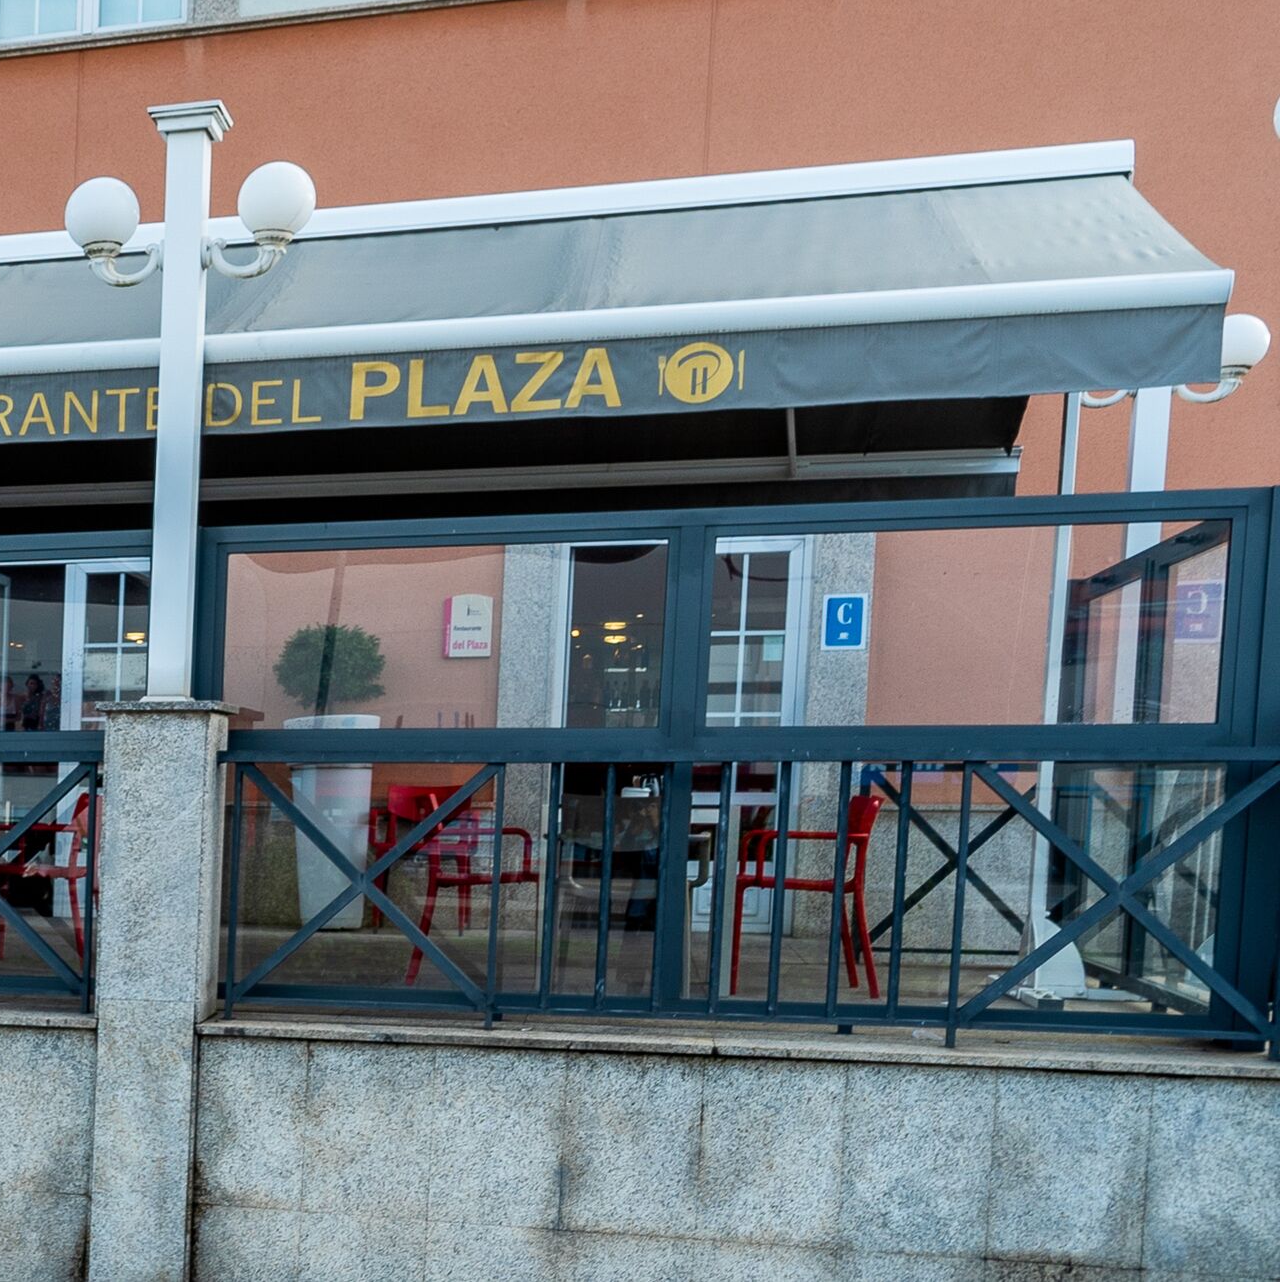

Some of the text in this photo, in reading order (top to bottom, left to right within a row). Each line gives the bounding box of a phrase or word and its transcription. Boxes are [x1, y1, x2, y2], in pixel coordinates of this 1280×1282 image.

[206, 378, 322, 429] DEL
[349, 347, 621, 420] PLAZA
[837, 602, 853, 625] C
[452, 640, 488, 650] del Plaza
